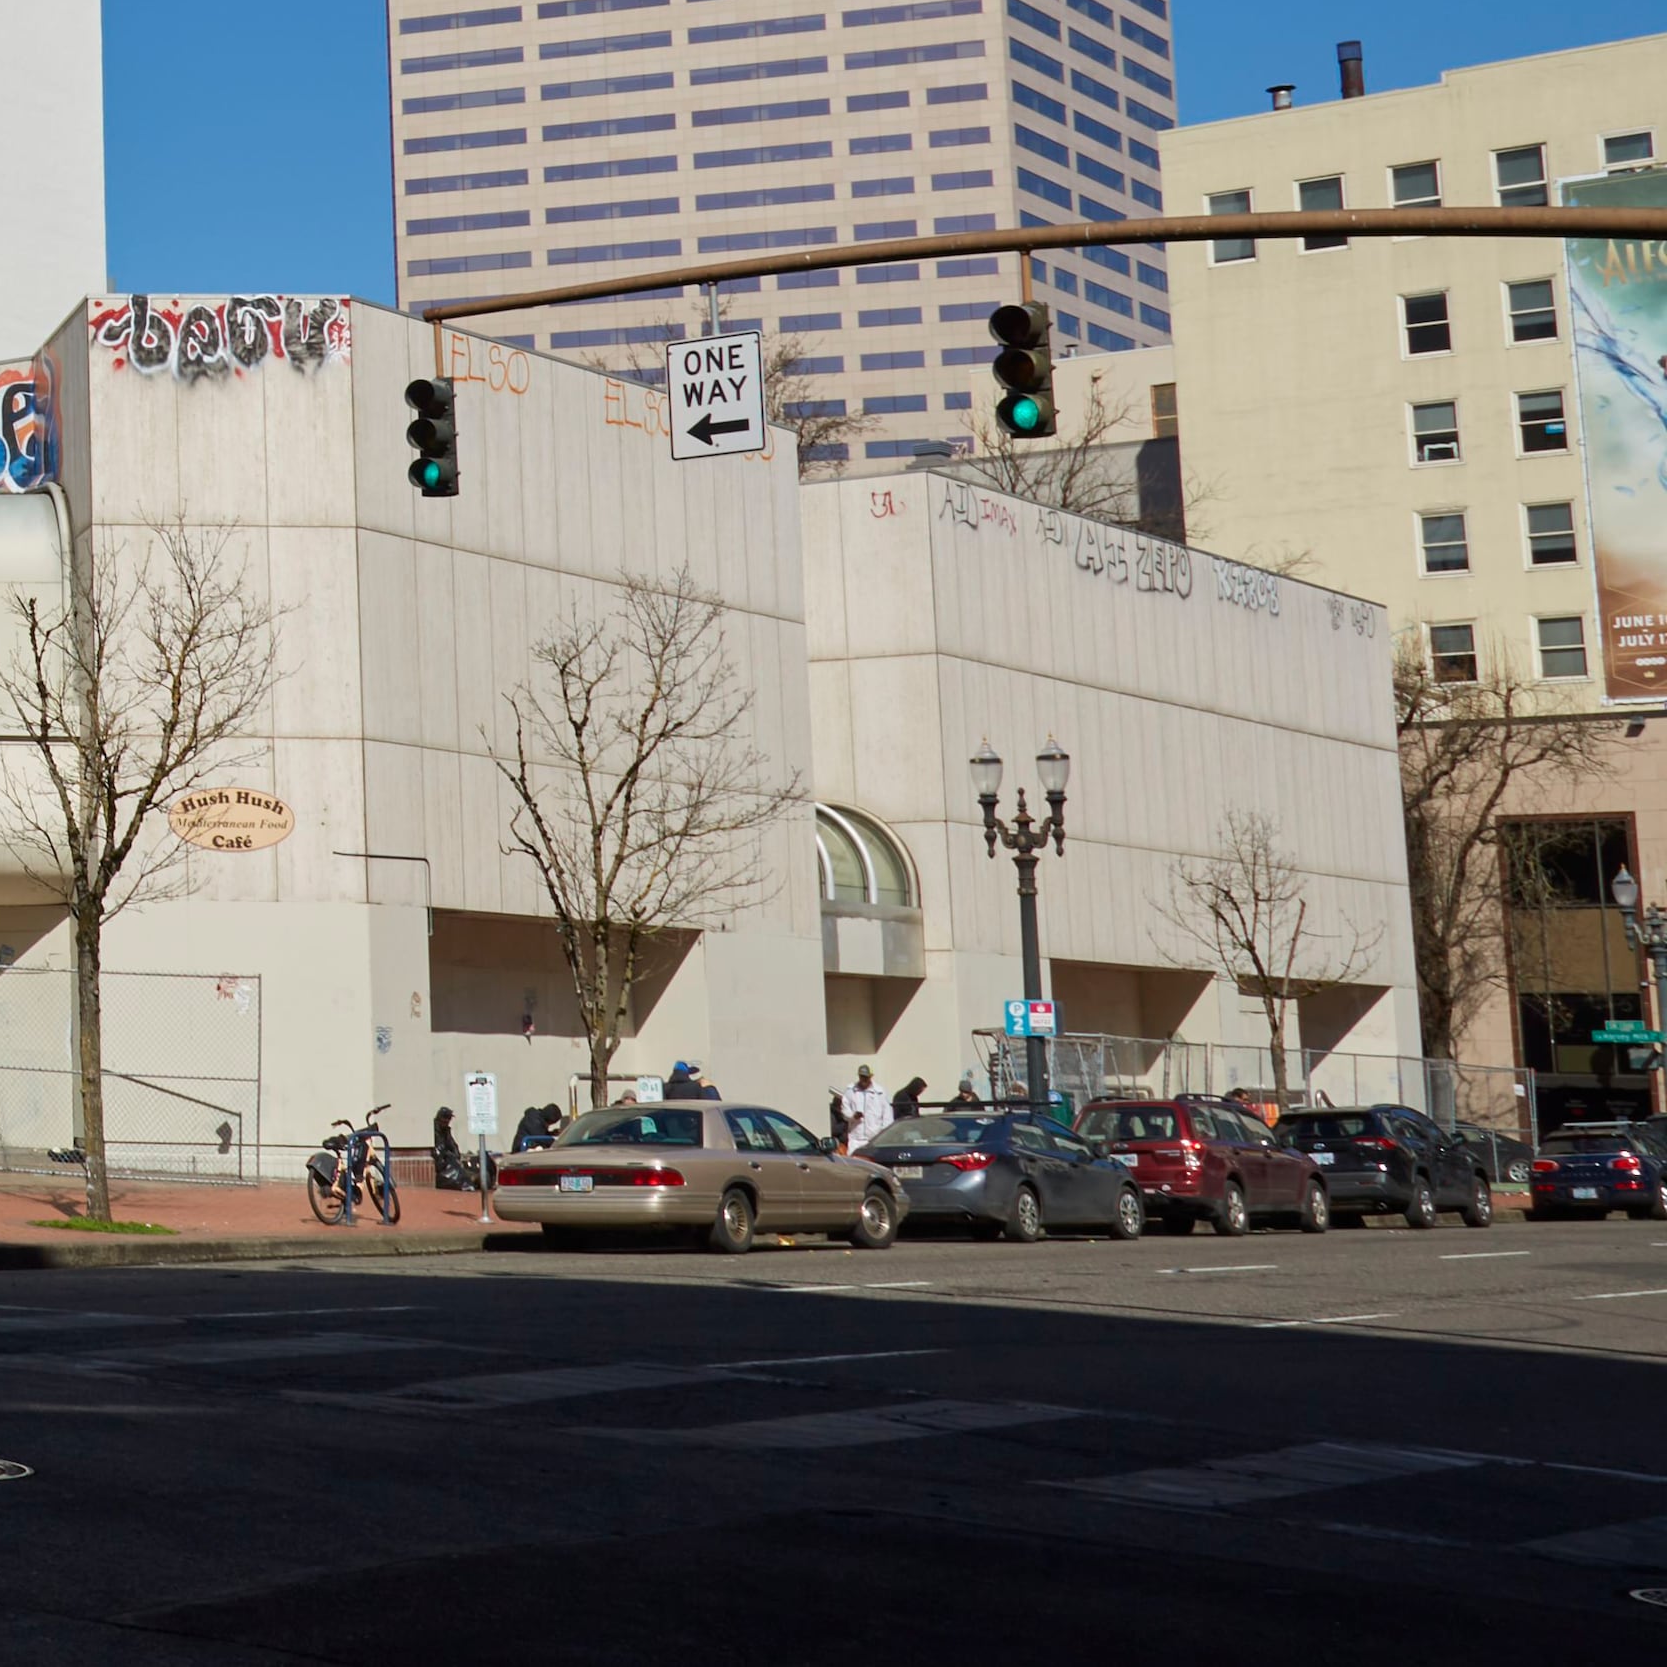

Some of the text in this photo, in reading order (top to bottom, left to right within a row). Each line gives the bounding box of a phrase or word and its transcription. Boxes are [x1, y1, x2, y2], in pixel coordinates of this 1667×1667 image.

[451, 334, 530, 395] ELSO
[684, 344, 745, 375] ONE
[683, 375, 747, 407] WAY
[1613, 615, 1655, 628] JUNE
[1618, 634, 1655, 648] JULY
[180, 791, 284, 816] Hush Hush
[259, 819, 288, 830] Food
[212, 834, 253, 849] Café
